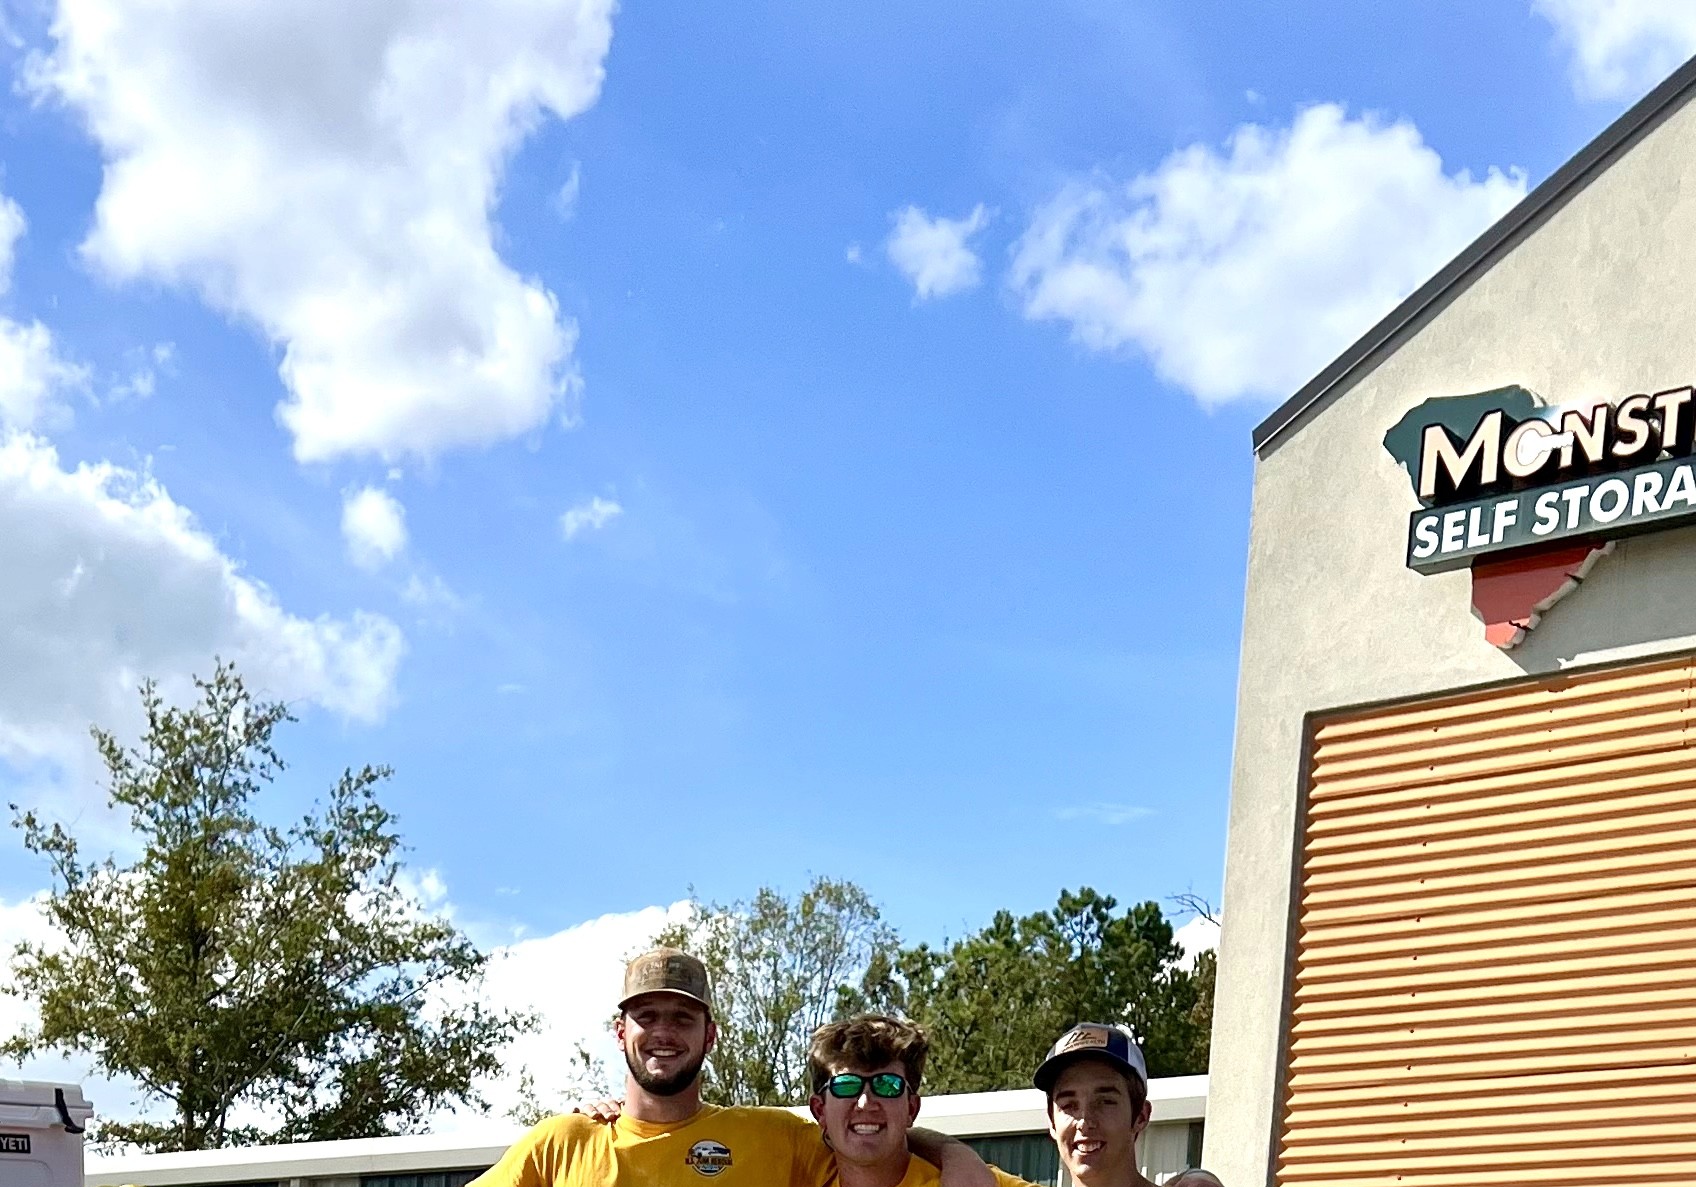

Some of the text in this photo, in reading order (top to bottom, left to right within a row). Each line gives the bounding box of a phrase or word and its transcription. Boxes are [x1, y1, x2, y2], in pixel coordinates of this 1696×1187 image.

[1418, 385, 1696, 497] MONST
[1412, 499, 1520, 559] SELF
[0, 1136, 28, 1151] YETI
